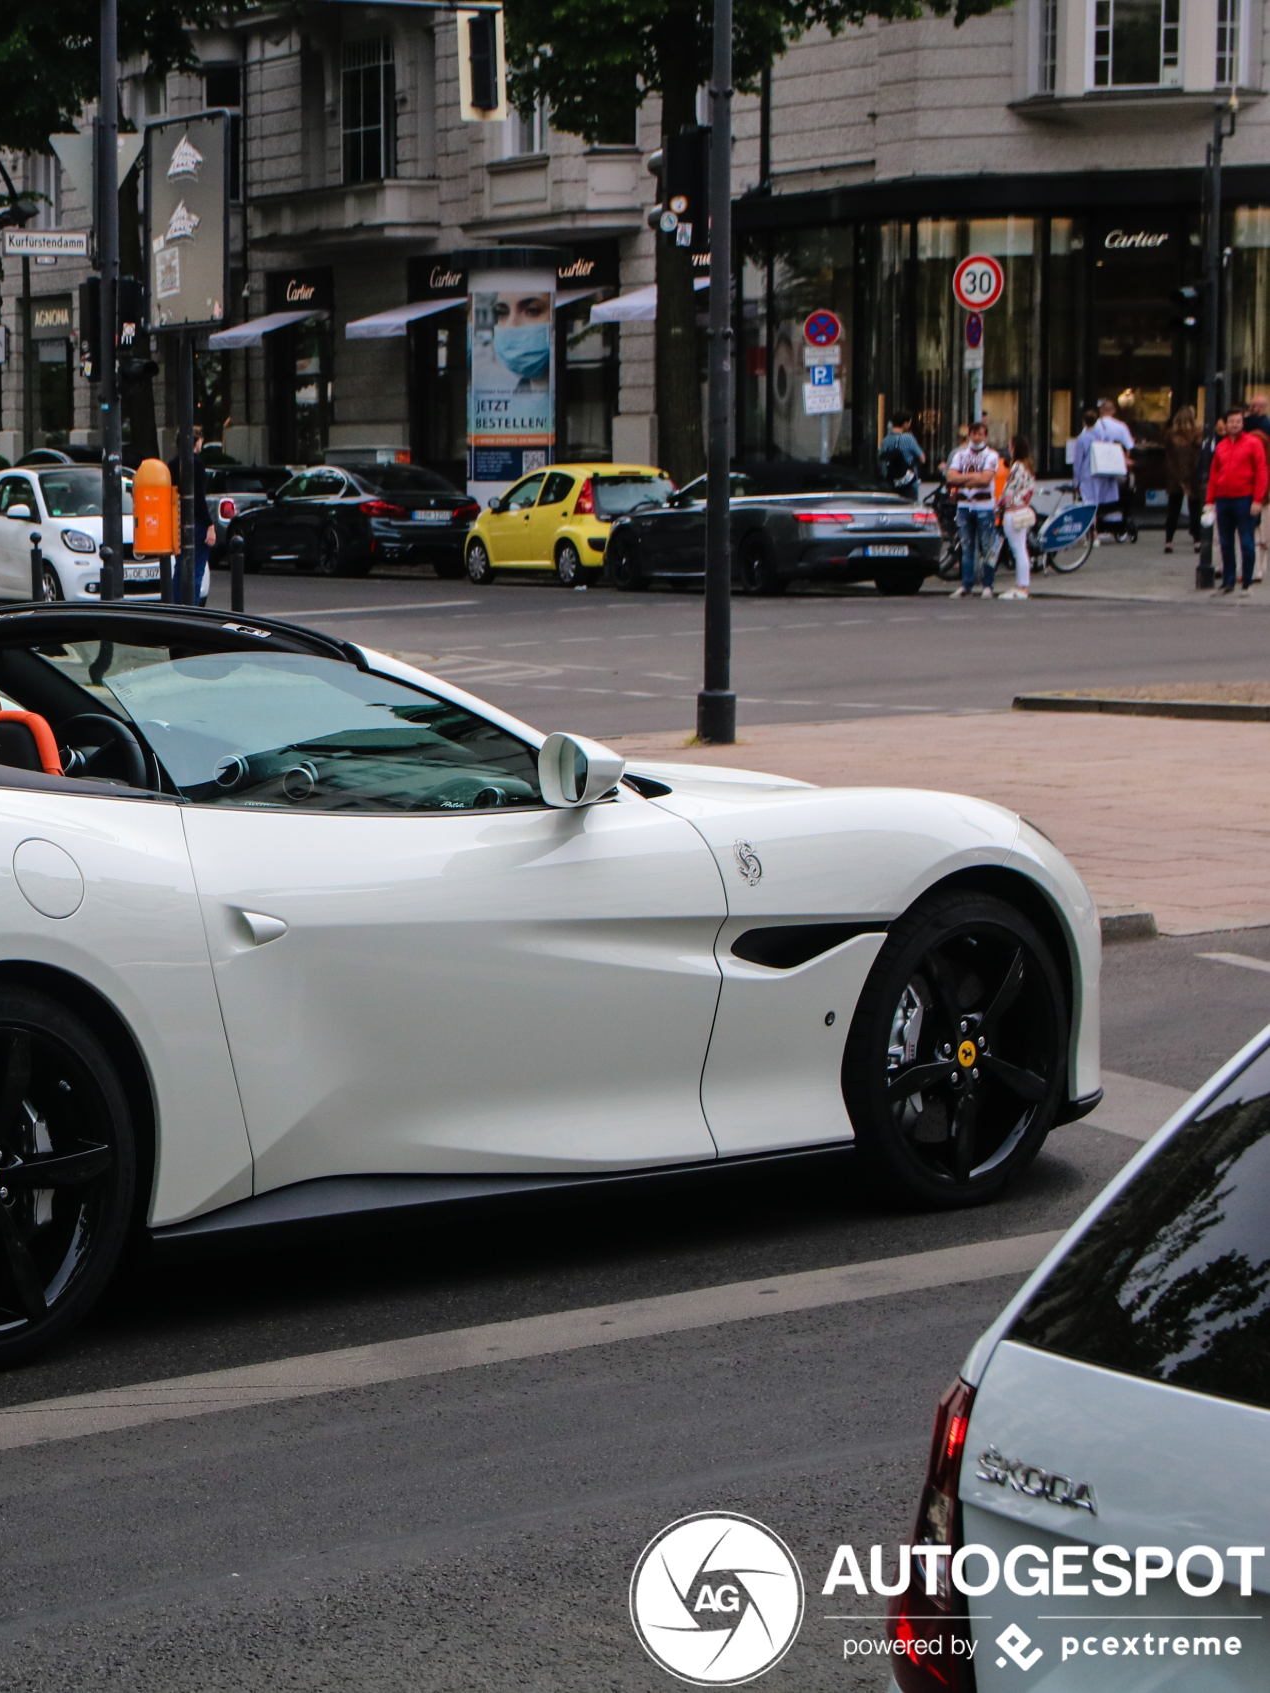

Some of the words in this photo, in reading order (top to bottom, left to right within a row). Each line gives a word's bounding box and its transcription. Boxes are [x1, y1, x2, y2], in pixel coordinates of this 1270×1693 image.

[8, 235, 85, 249] Kurfürstendamm
[1105, 229, 1168, 248] Cartier
[430, 266, 462, 288] Cartier
[965, 270, 991, 294] 30
[286, 279, 315, 302] Cartier
[35, 309, 69, 327] AGNONA
[477, 400, 510, 415] JETZT
[475, 418, 547, 429] BESTELLEN!
[975, 1443, 1098, 1517] ŠKODA
